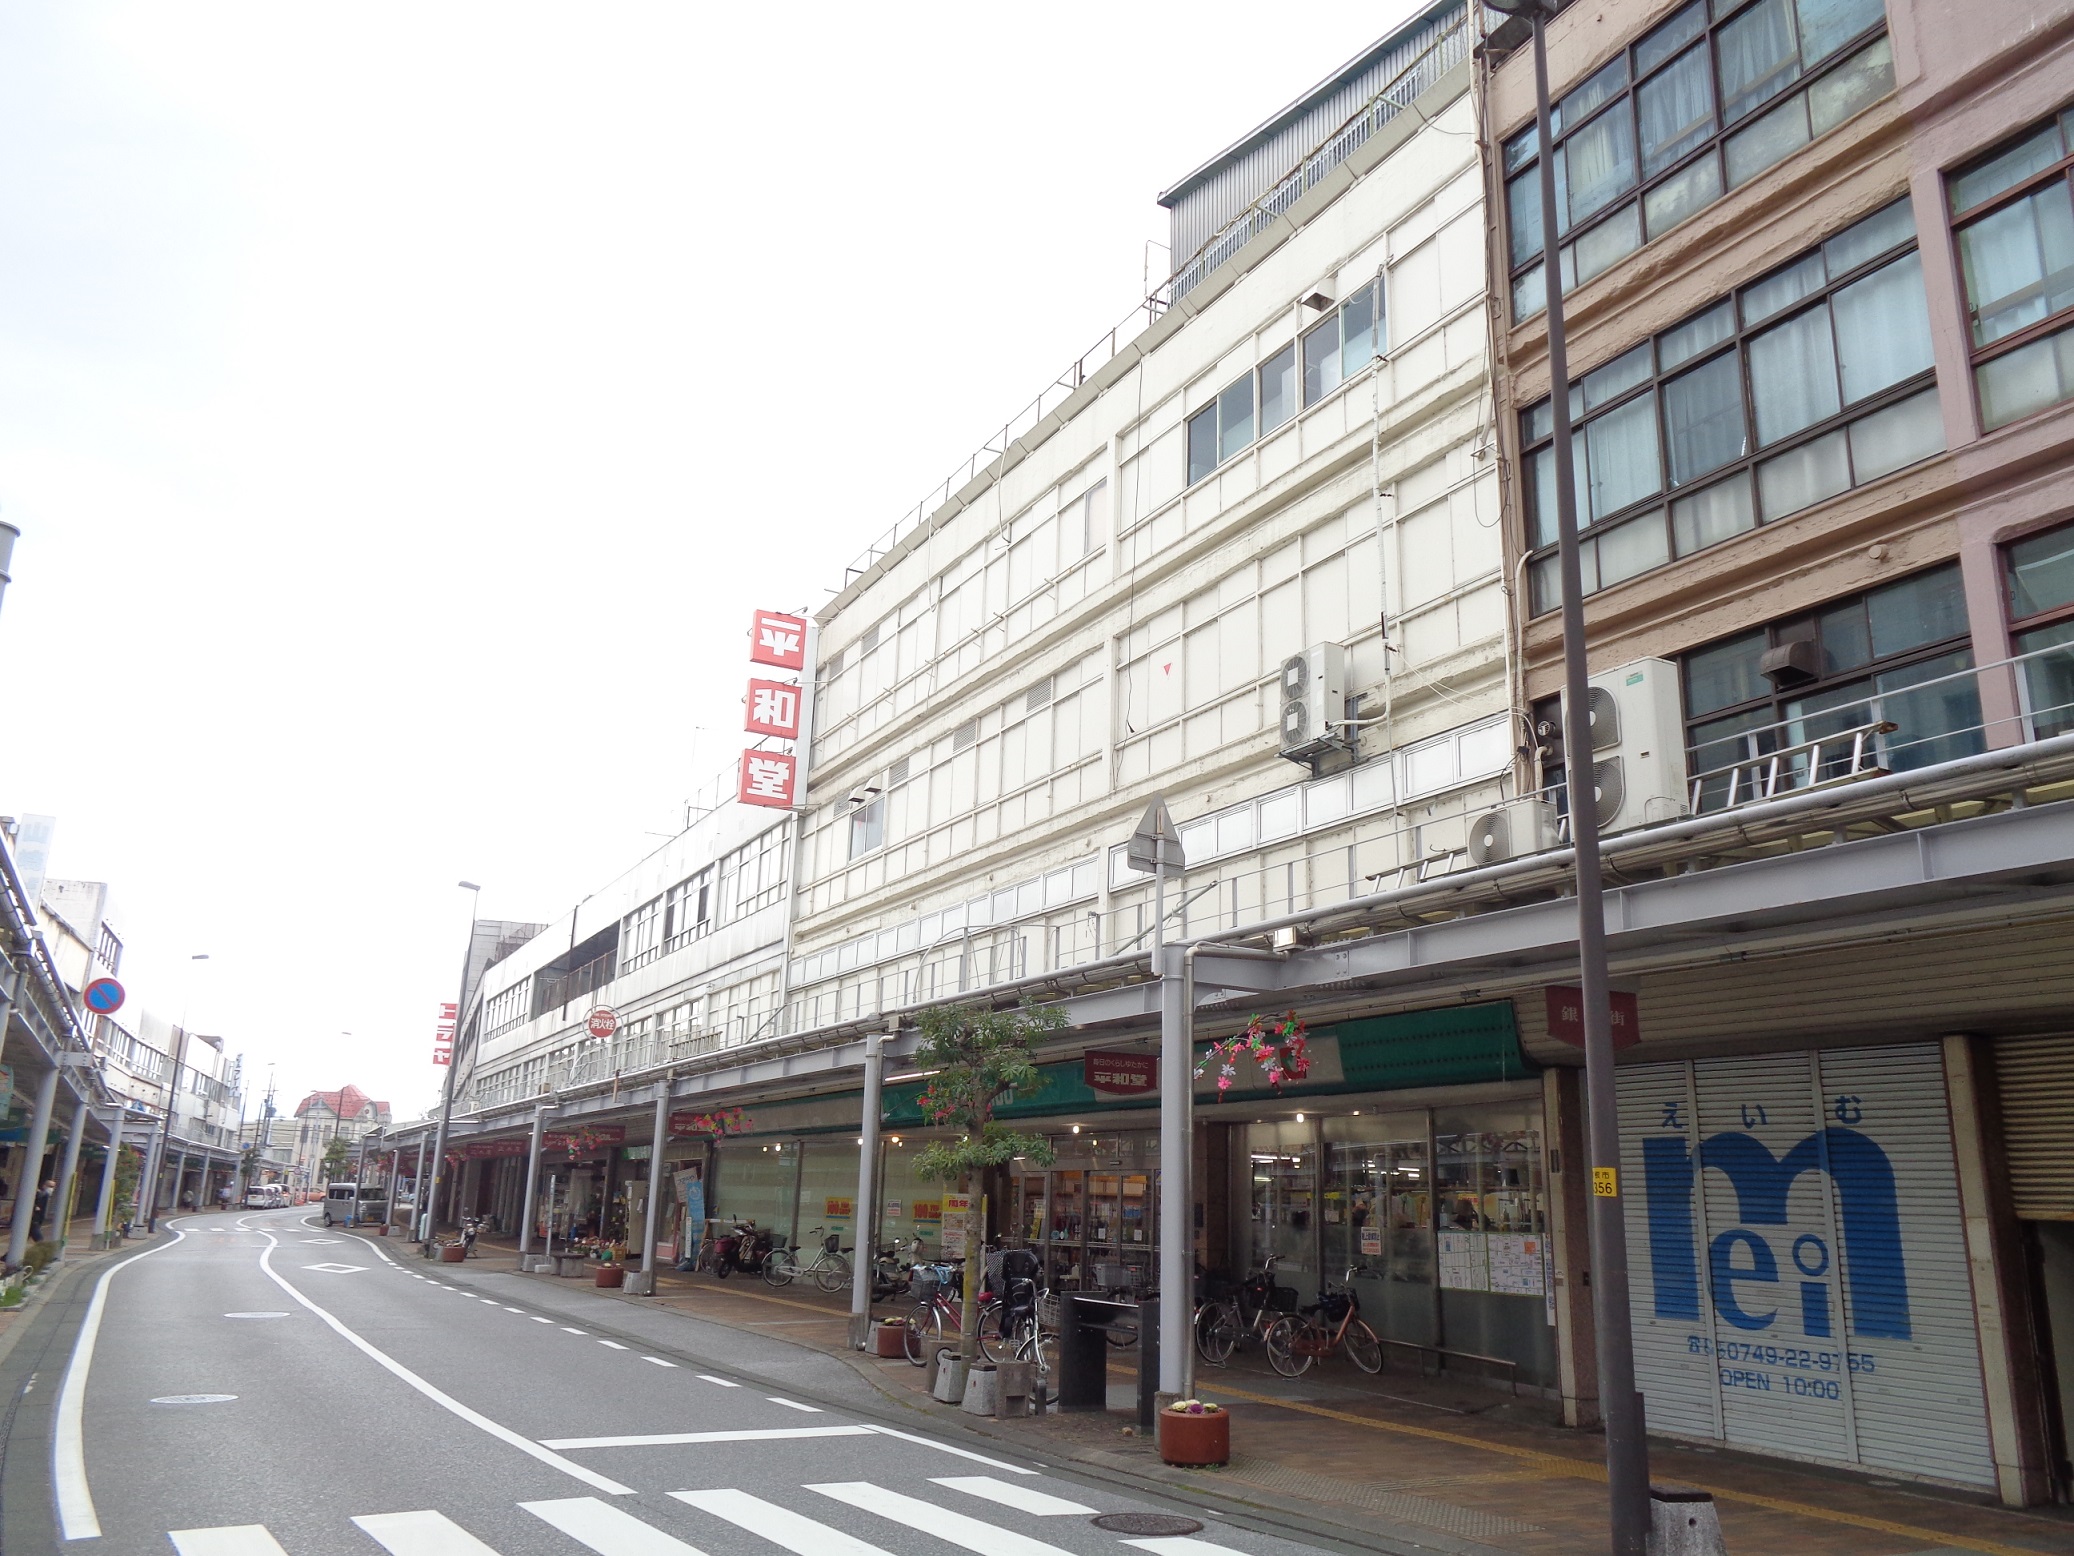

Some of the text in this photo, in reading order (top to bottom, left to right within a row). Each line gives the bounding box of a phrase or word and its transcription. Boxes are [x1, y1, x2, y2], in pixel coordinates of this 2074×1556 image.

[747, 616, 802, 800] 平和堂
[590, 1018, 615, 1030] 消火栓
[1561, 1006, 1625, 1026] 銀街
[433, 1003, 457, 1064] トラヤ
[1093, 1058, 1149, 1069] 毎日のくらしゆたかに
[1093, 1071, 1148, 1087] 平和堂
[1720, 1368, 1840, 1400] OPEN 10:00
